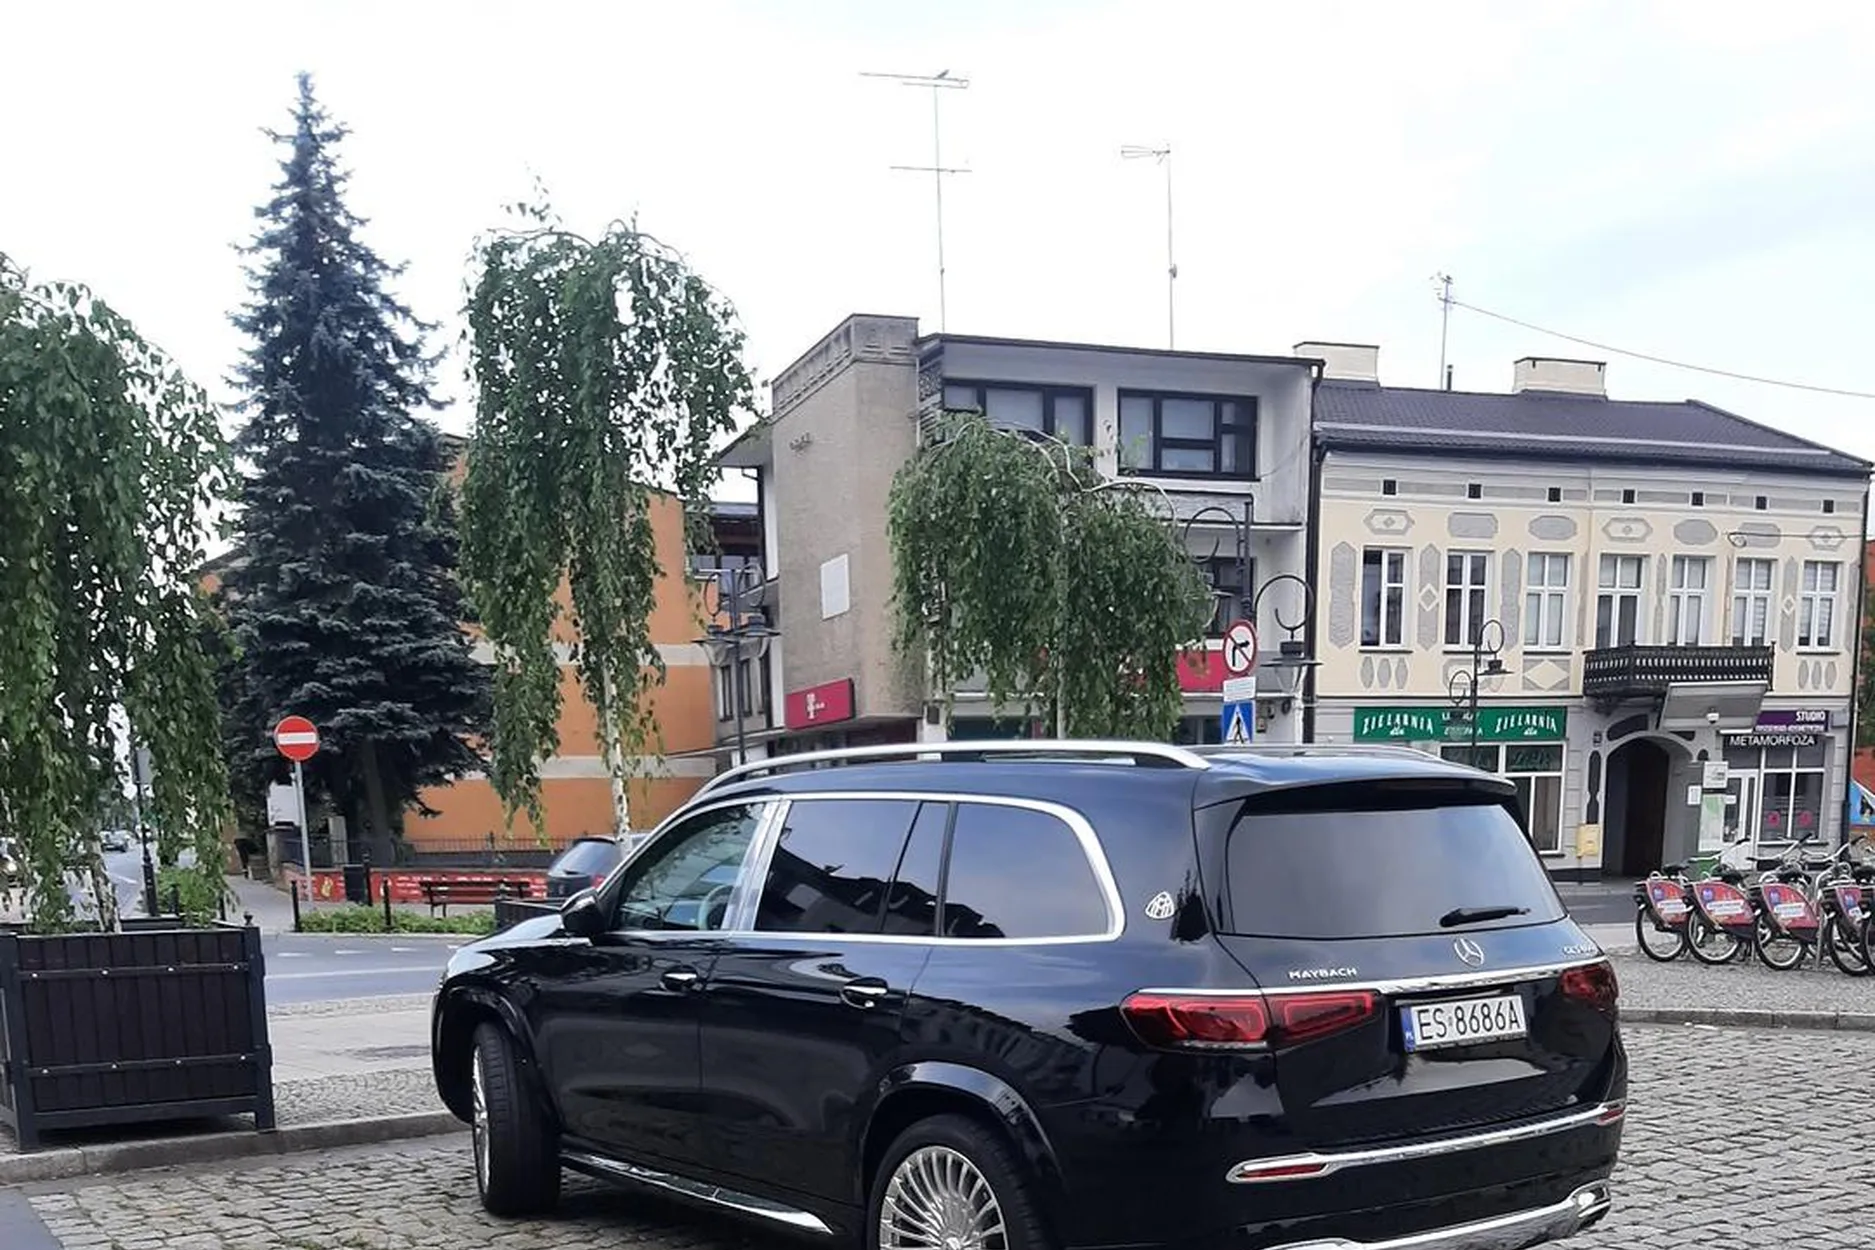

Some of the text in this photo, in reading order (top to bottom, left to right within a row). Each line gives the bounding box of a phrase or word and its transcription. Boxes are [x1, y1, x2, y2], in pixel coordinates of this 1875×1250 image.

[1362, 713, 1434, 735] ZIELARNIA
[1494, 713, 1557, 734] ZIELARNIA
[1796, 711, 1826, 722] STUDIO
[1729, 735, 1816, 746] METAMORFOZA
[1288, 967, 1358, 980] MAYBACH
[1417, 1000, 1520, 1040] ES 8686A
